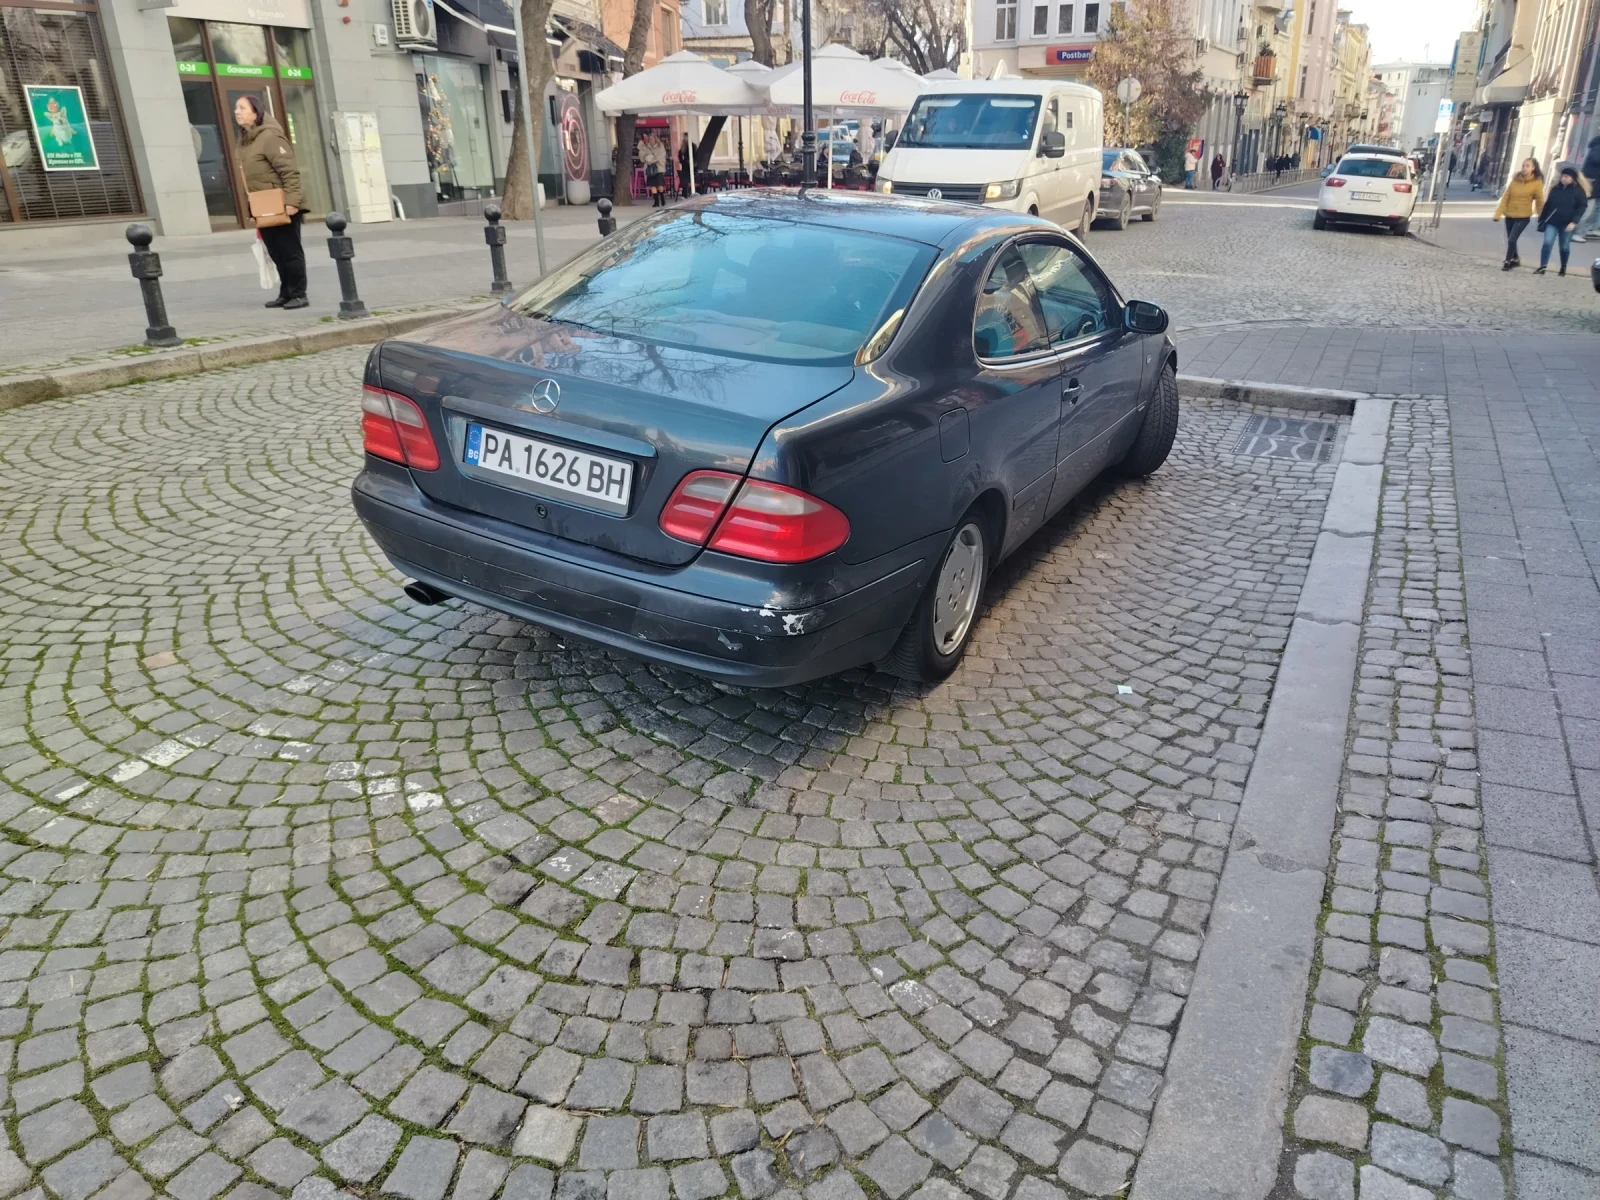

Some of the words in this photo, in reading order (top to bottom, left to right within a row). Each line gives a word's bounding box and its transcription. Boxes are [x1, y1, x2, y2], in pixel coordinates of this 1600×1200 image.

[1061, 50, 1091, 60] Postban
[179, 63, 196, 72] 0-24
[226, 65, 263, 75] банкомат
[287, 68, 302, 77] 0-24
[468, 449, 479, 461] BG
